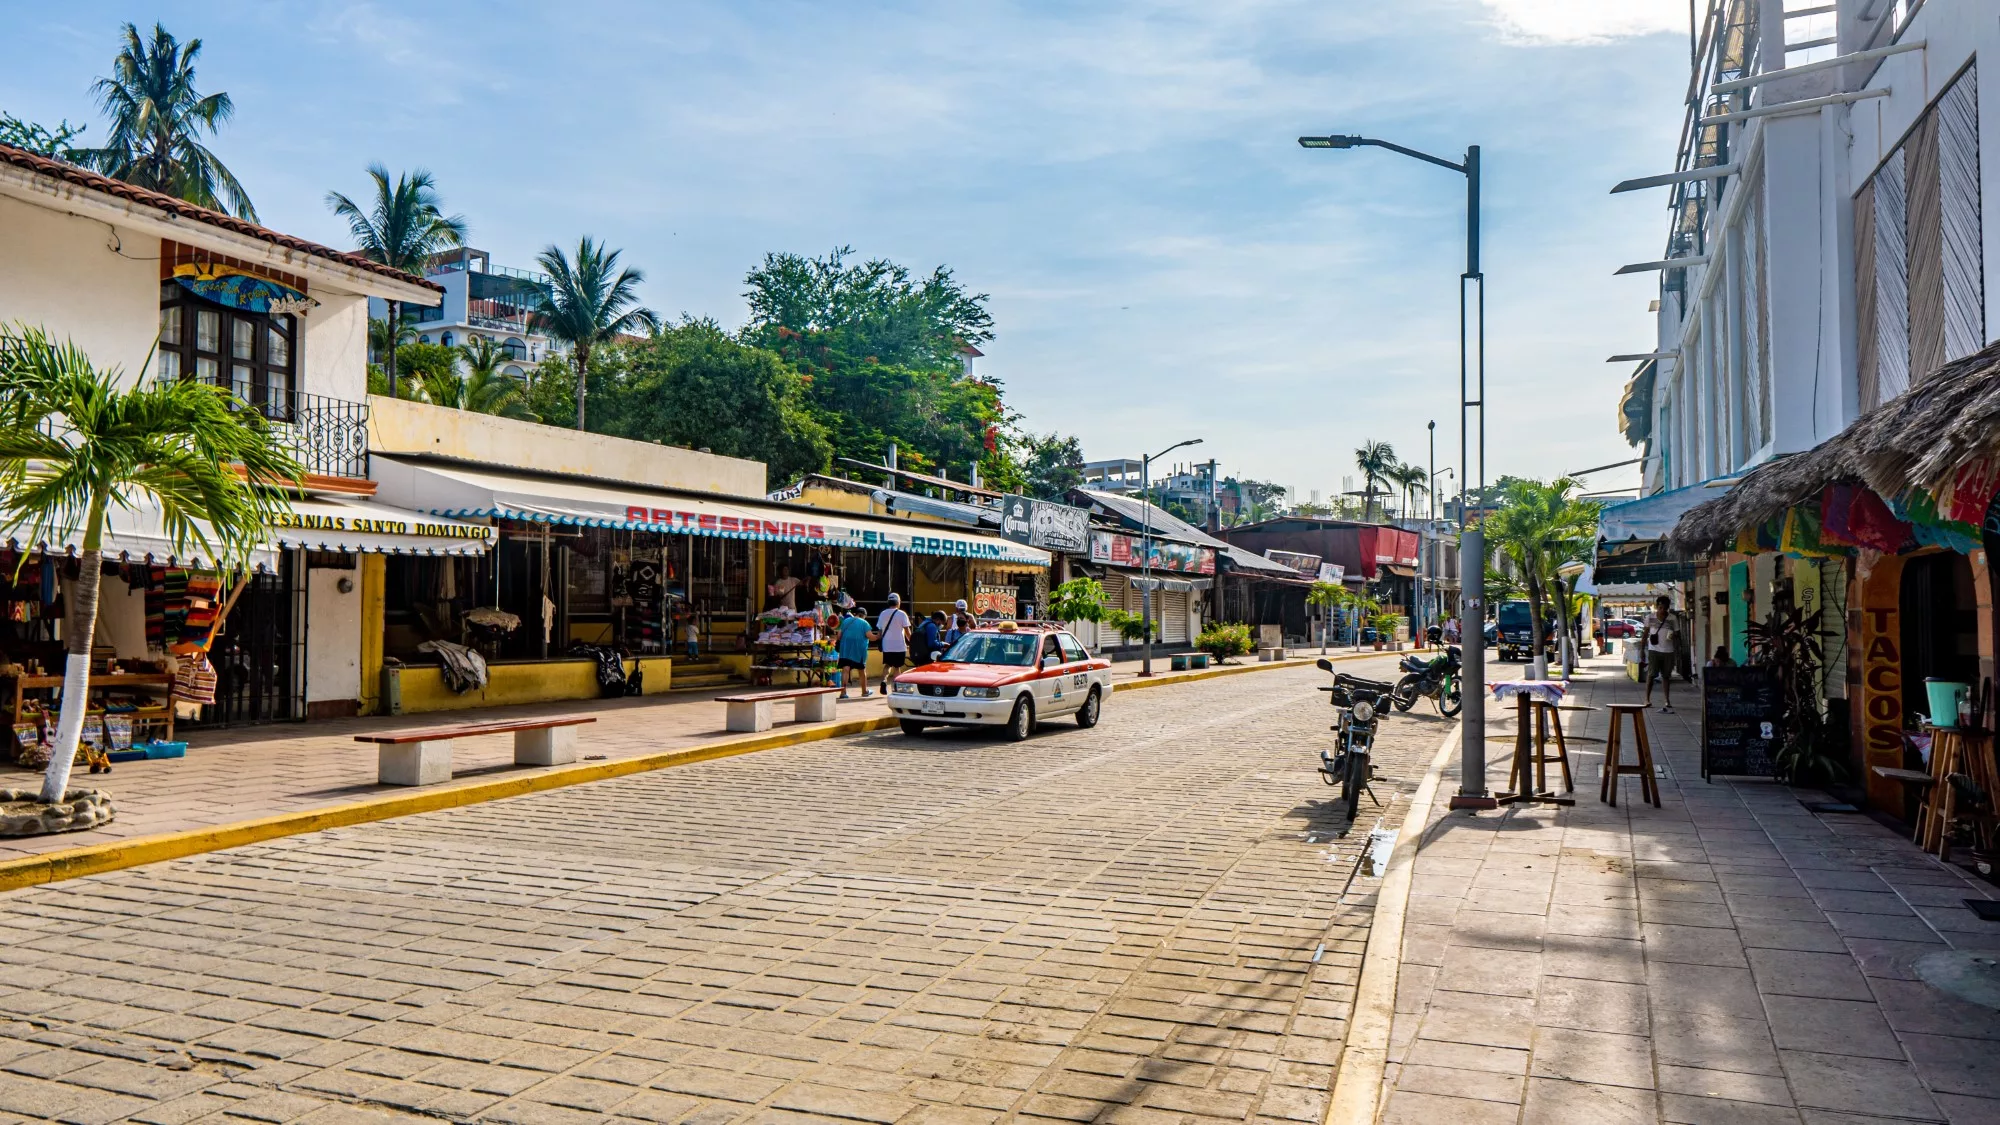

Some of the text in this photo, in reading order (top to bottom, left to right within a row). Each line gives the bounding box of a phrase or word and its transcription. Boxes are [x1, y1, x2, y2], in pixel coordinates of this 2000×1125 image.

[351, 518, 407, 535] SANTO
[415, 522, 491, 539] DOMINGO
[626, 505, 825, 539] ARTESANIAS
[1003, 514, 1029, 535] Corona
[973, 592, 1016, 616] CONGO
[1866, 608, 1903, 750] TACOS
